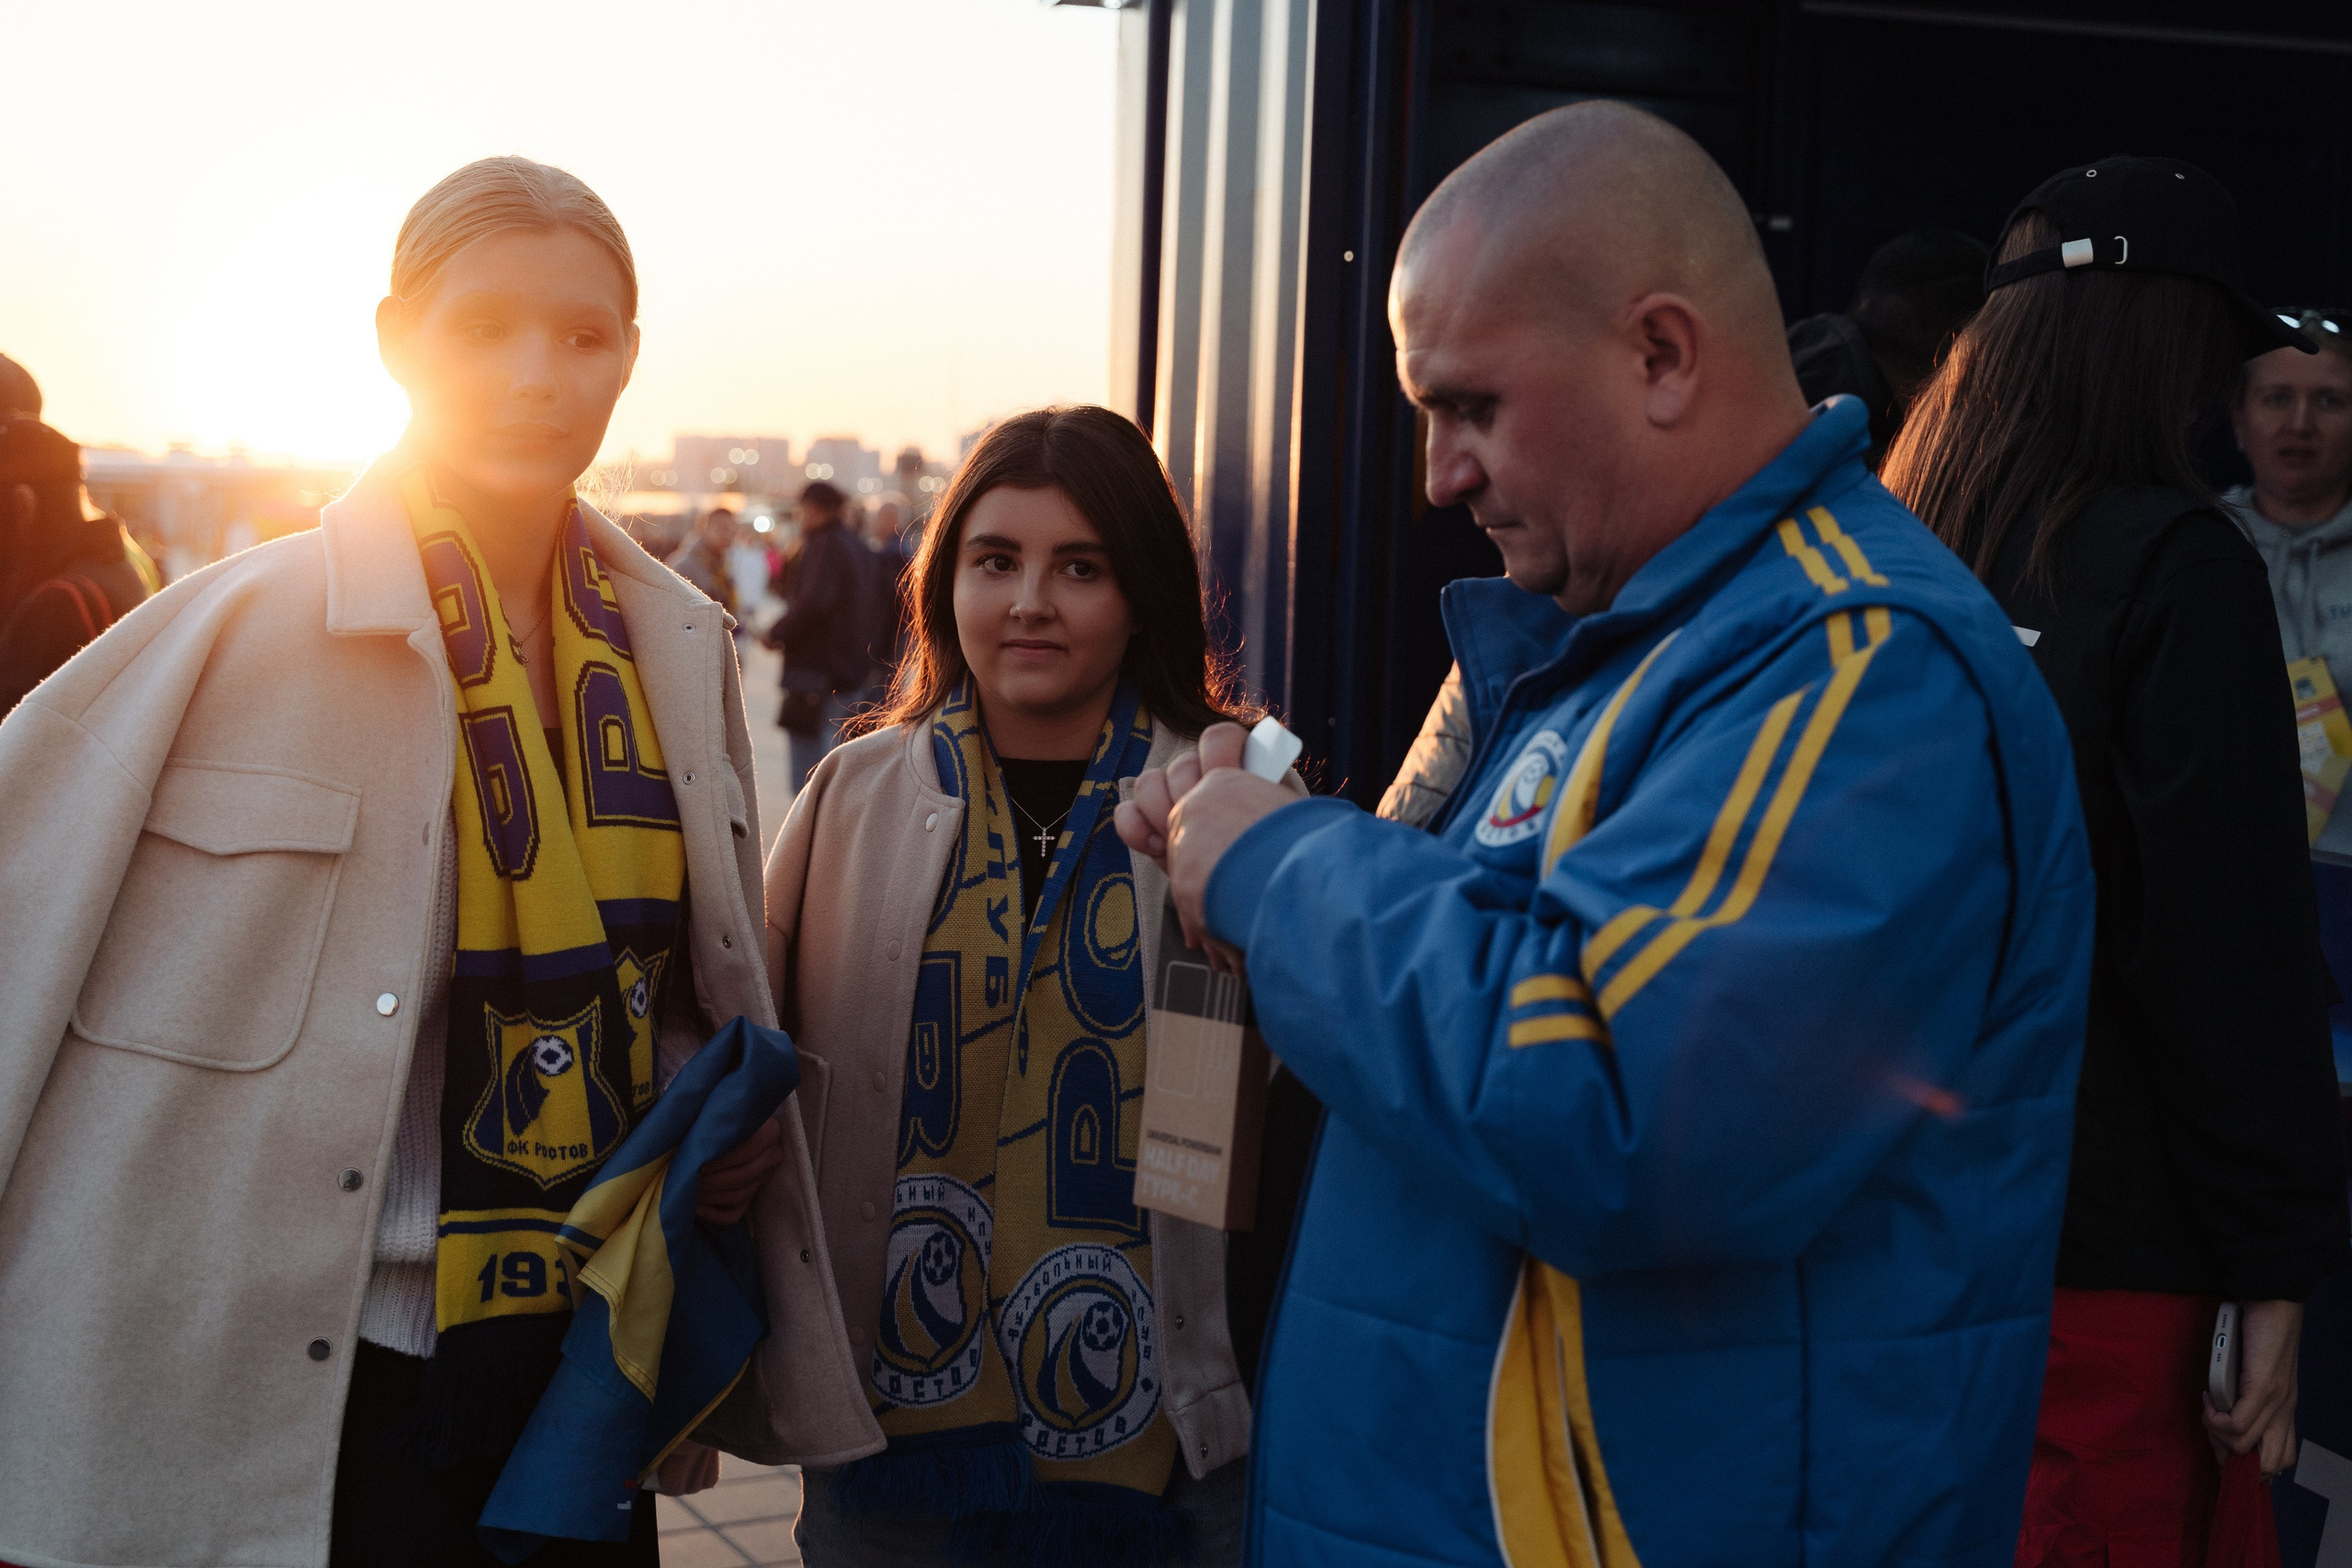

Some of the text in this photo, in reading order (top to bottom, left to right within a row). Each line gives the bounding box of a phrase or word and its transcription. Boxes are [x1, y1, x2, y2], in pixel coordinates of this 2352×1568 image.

[507, 1139, 589, 1160] ФК РОСТОВ
[1143, 1144, 1186, 1174] HALF
[1140, 1172, 1199, 1208] TYPE-C
[967, 1207, 992, 1255] КЛУ
[1007, 1253, 1112, 1342] ФУТБОЛЬНЫЙ
[1131, 1288, 1152, 1360] КЛУБ
[873, 1348, 978, 1398] РОСТОВ
[1021, 1414, 1127, 1455] РОСТОВ
